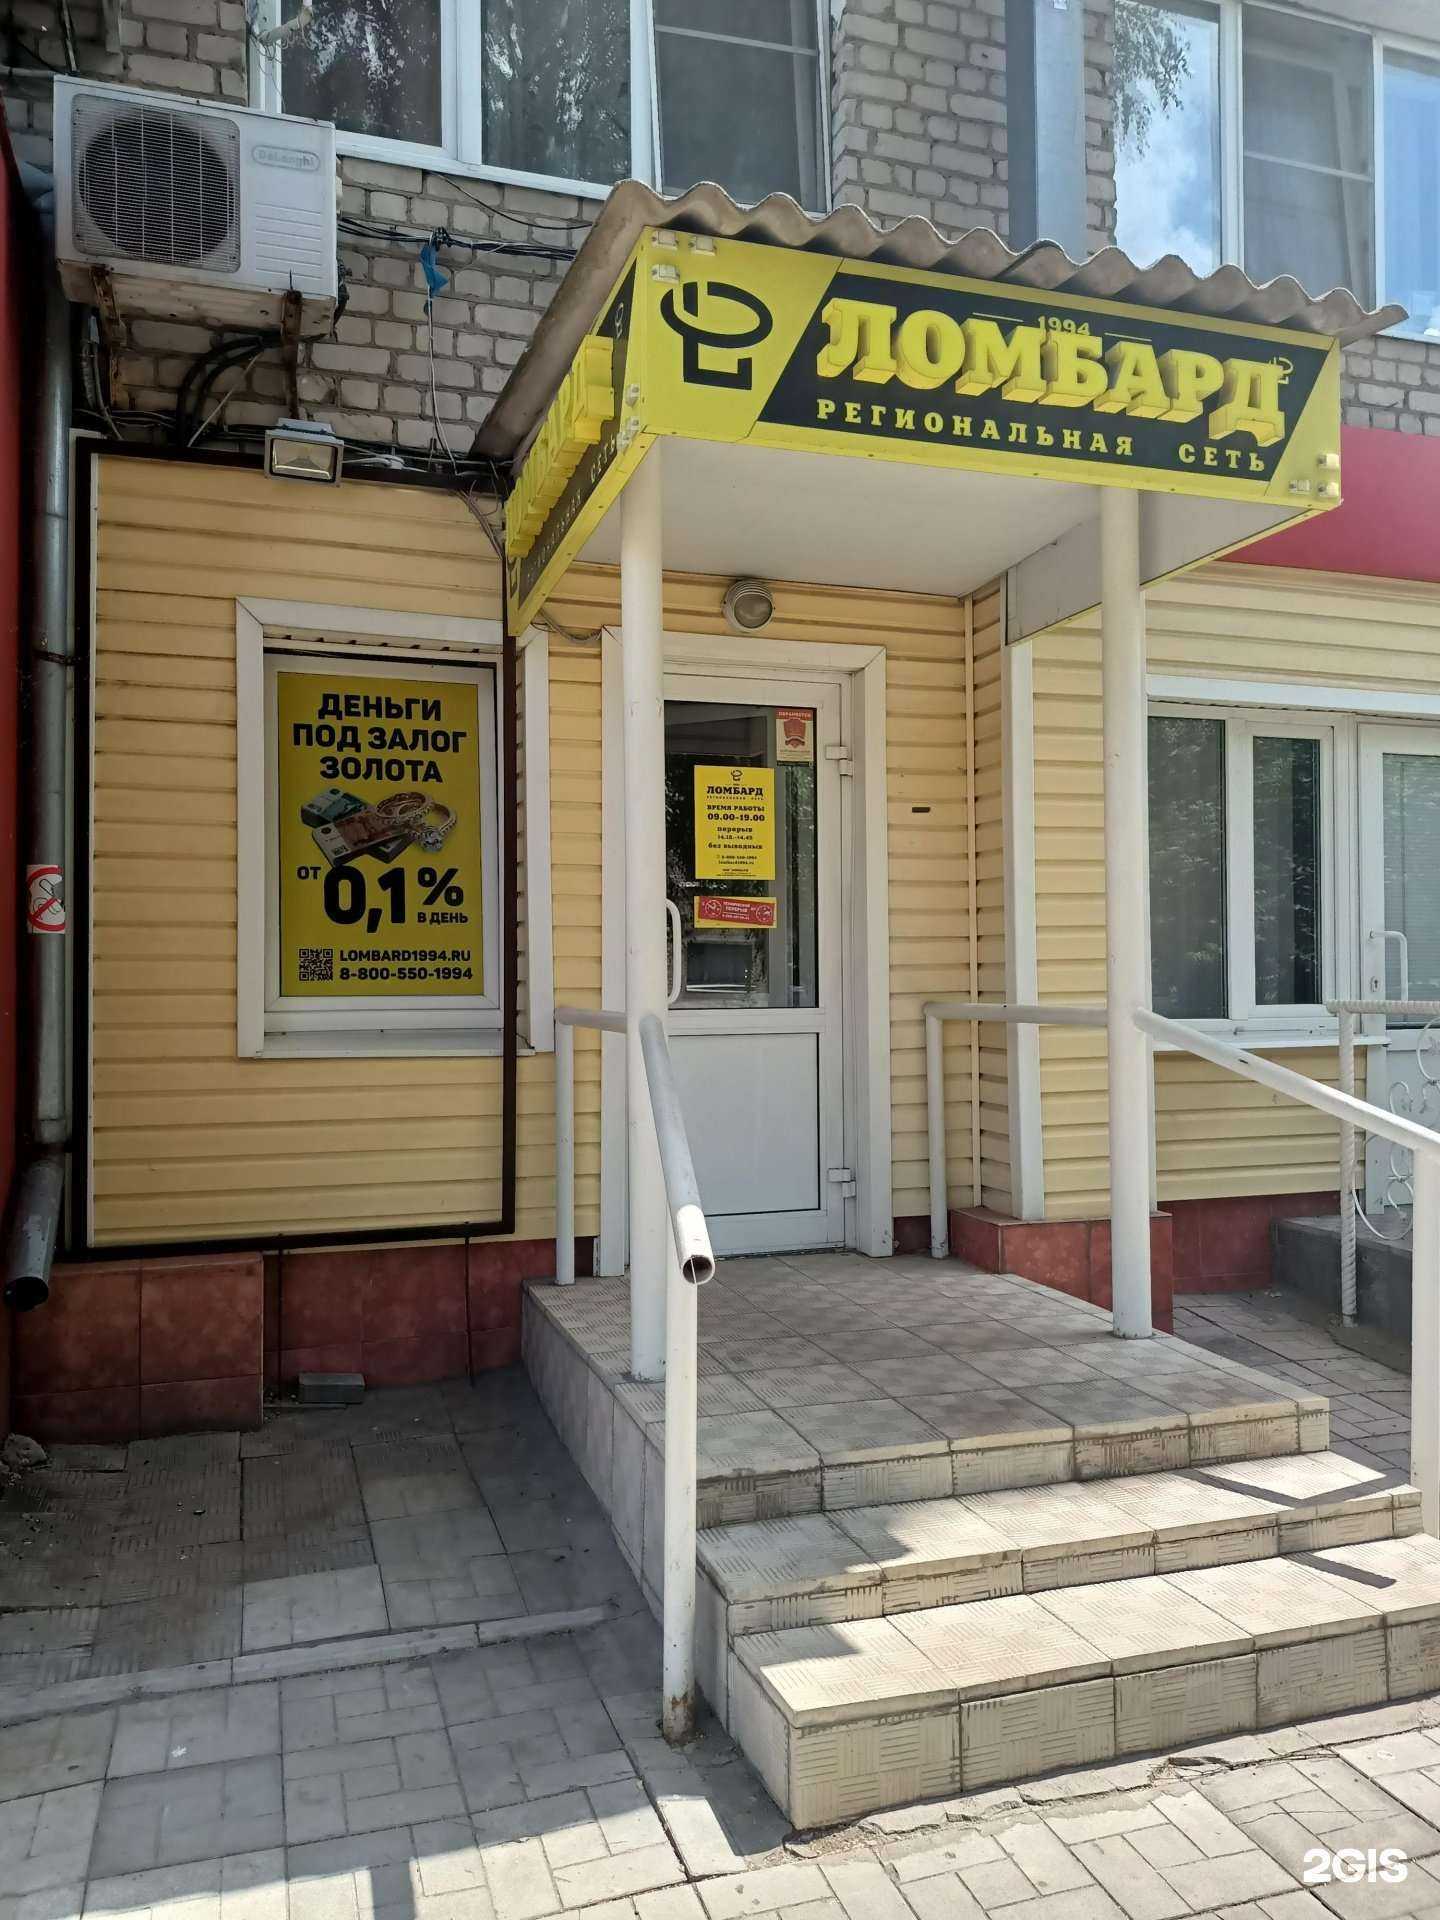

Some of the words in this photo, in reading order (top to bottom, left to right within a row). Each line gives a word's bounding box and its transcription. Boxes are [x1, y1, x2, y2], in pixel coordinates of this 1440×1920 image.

[1038, 315, 1090, 335] 1994
[817, 297, 1285, 447] ЛОМБАРД
[816, 398, 1134, 456] РЕГИОНАЛЬНАЯ
[1177, 443, 1265, 472] СЕТЬ
[318, 694, 441, 722] ДЕНЬГИ
[293, 723, 361, 752] ПОД
[367, 727, 467, 753] ЗАЛОГ
[320, 757, 443, 783] ЗОЛОТА
[707, 786, 763, 797] ЛОМБАРД
[707, 813, 765, 822] 09.00-19.00
[297, 866, 321, 880] ОТ
[417, 912, 427, 923] В
[429, 912, 469, 925] ДЕНЬ
[339, 950, 471, 962] LOMBARD1994.RU
[339, 967, 473, 980] 8-800-550-1994
